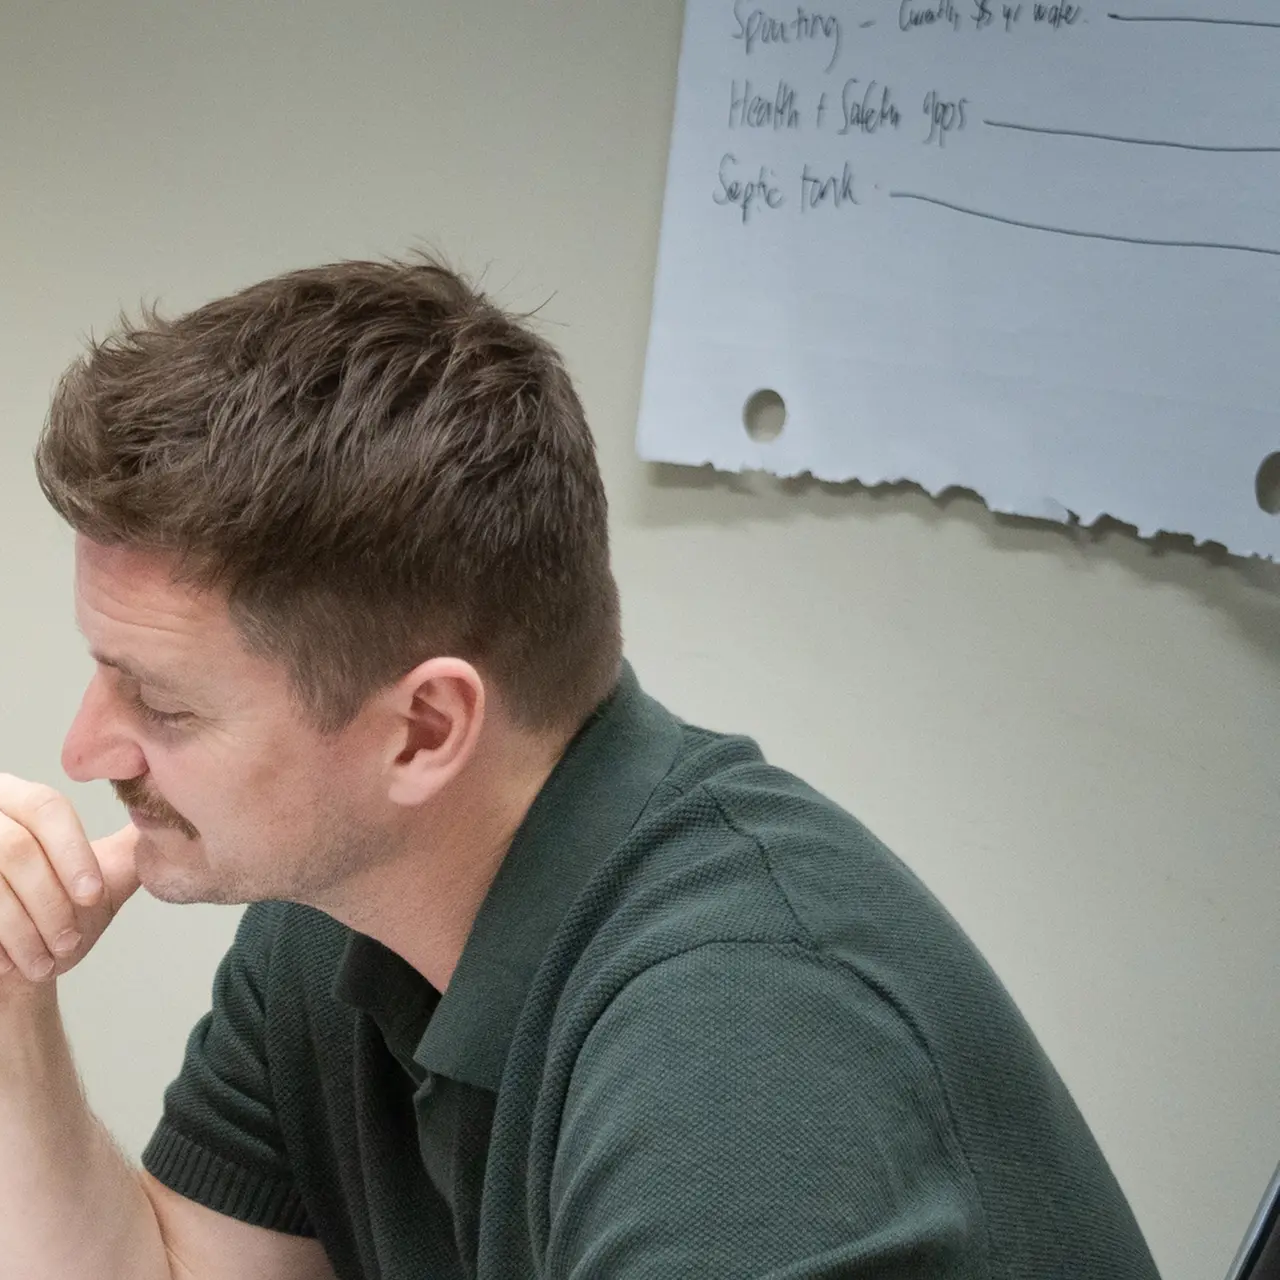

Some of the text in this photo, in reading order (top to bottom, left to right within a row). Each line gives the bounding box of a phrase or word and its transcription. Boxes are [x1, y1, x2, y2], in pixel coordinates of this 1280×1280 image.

[729, 79, 799, 131] Health
[713, 153, 862, 226] Septic tank
